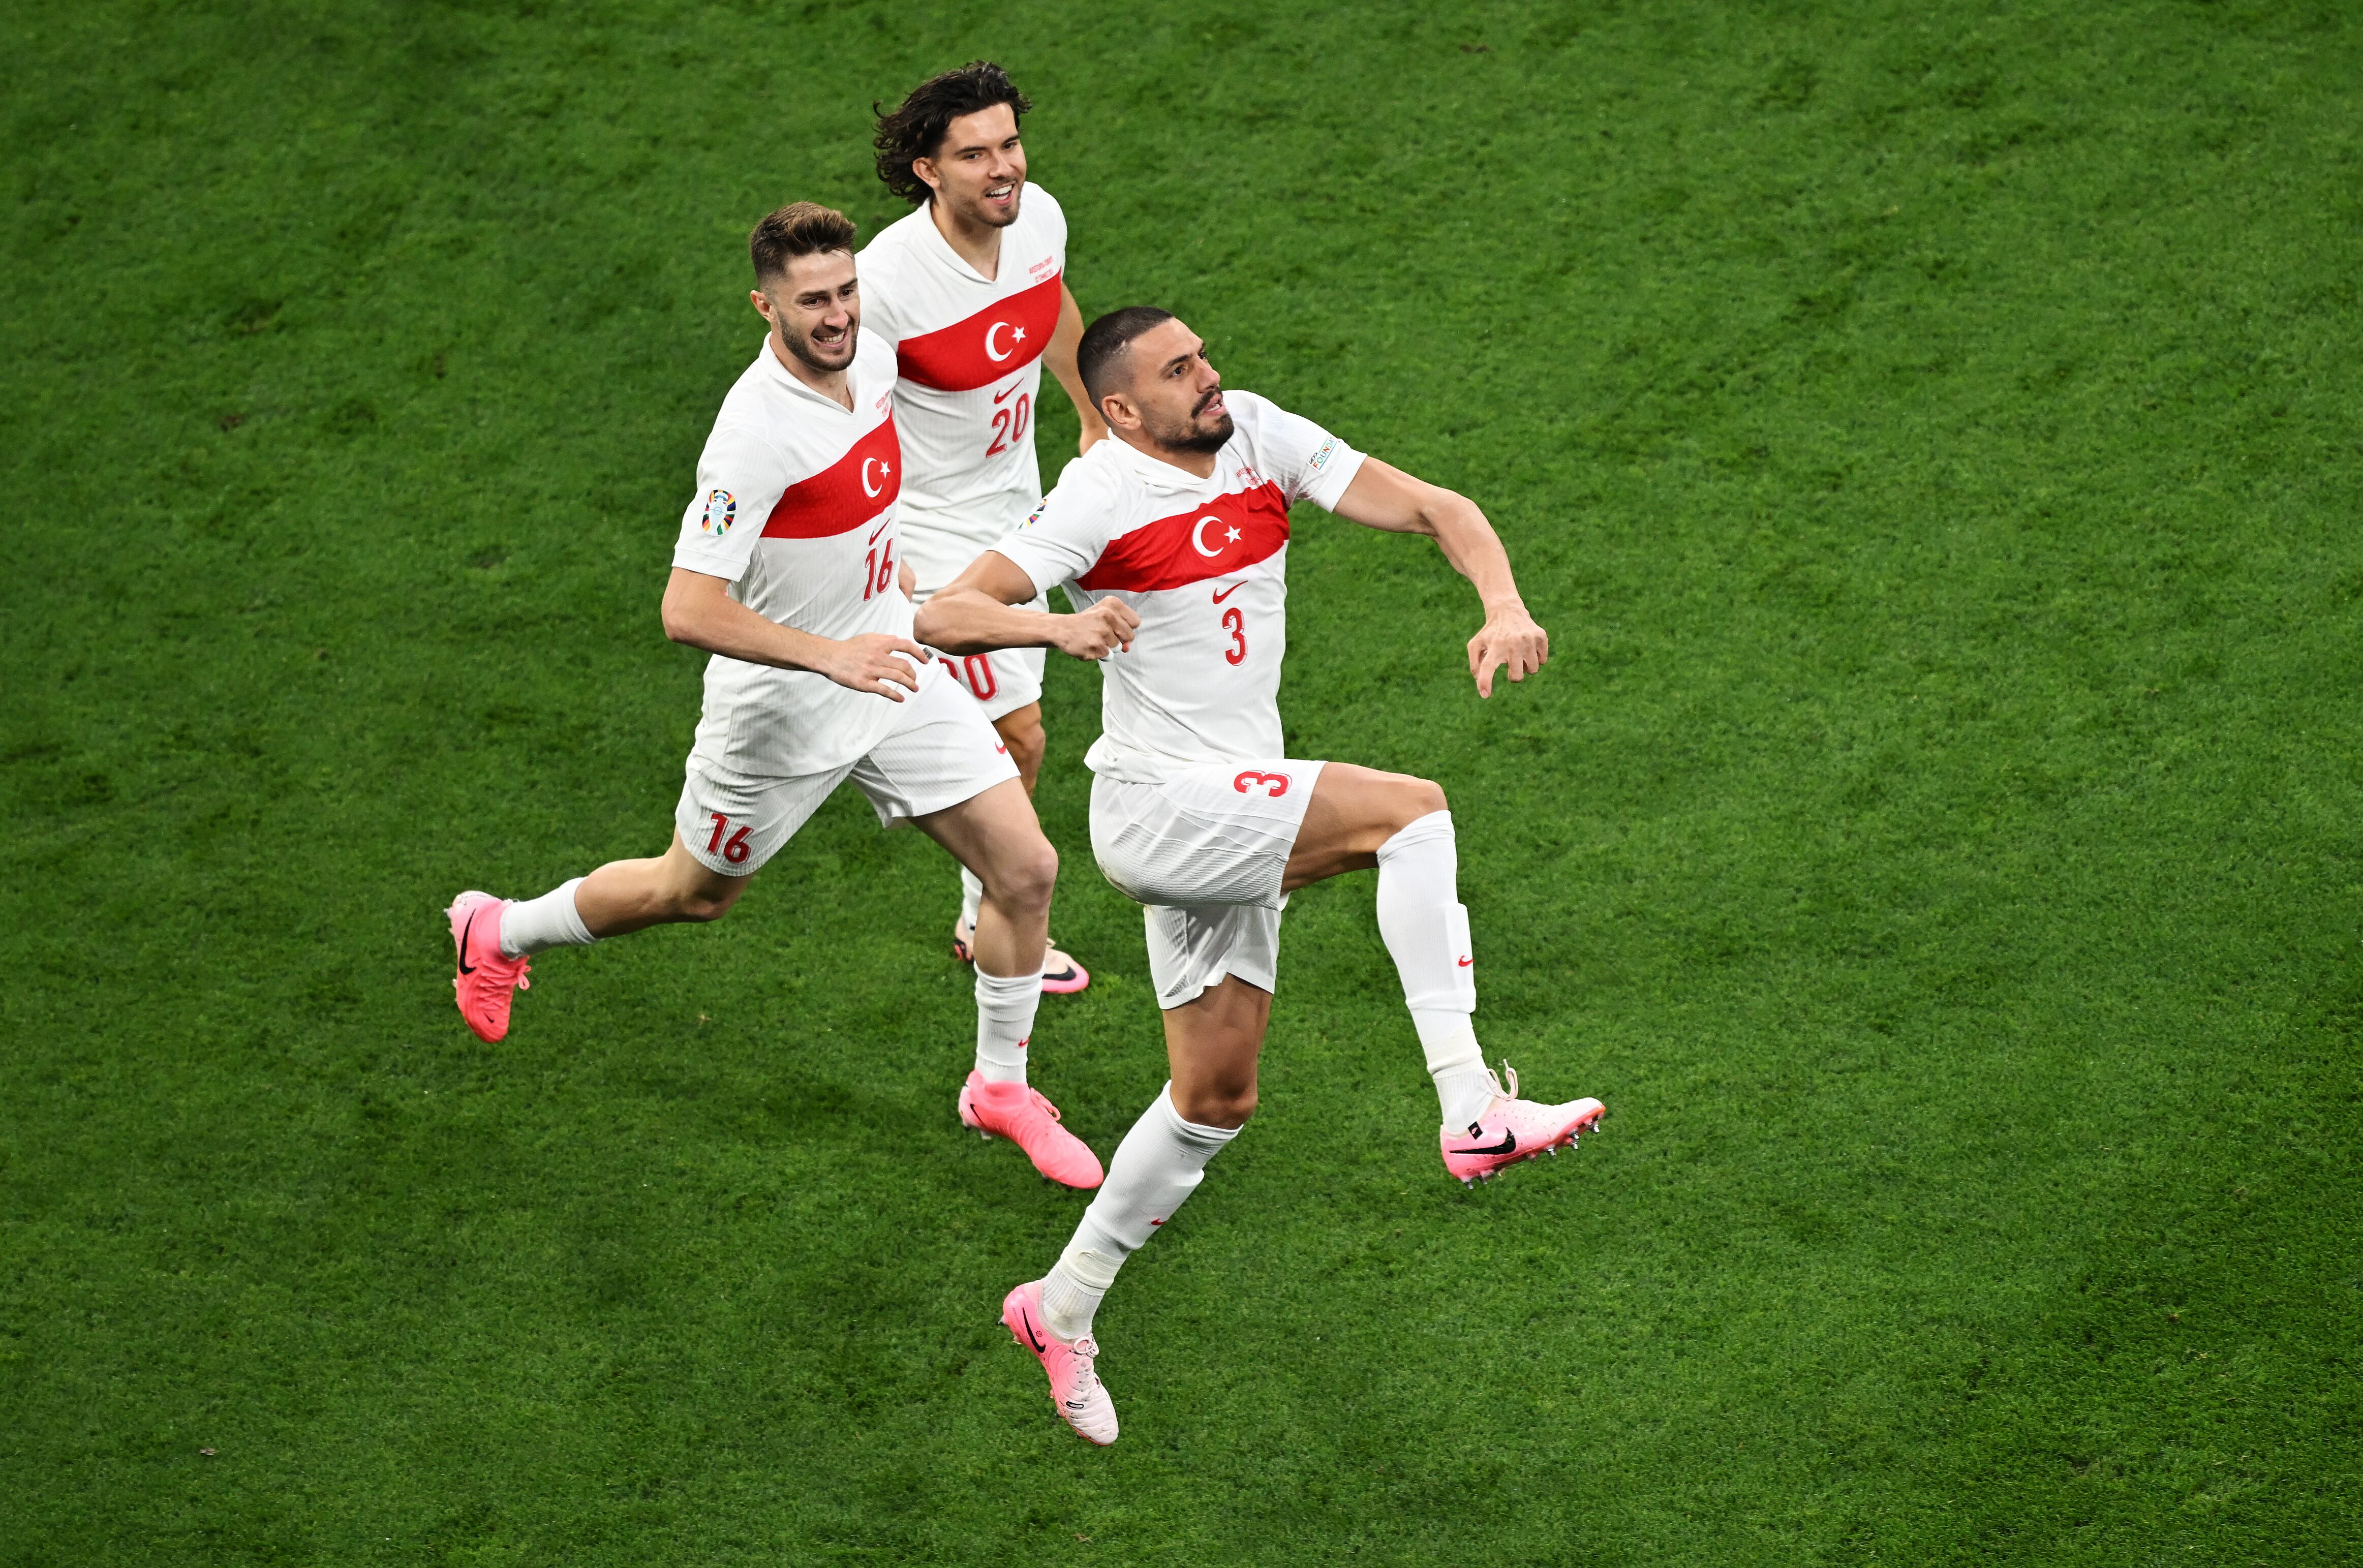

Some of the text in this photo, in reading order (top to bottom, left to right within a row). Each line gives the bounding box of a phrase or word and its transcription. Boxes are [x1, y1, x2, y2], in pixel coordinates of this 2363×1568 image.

[986, 393, 1029, 458] 20
[1309, 452, 1318, 464] UEFA
[1313, 437, 1336, 469] FOUNDAT
[864, 538, 893, 601] 16
[1222, 607, 1248, 666] 3
[1234, 770, 1292, 797] 3
[708, 813, 754, 865] 16
